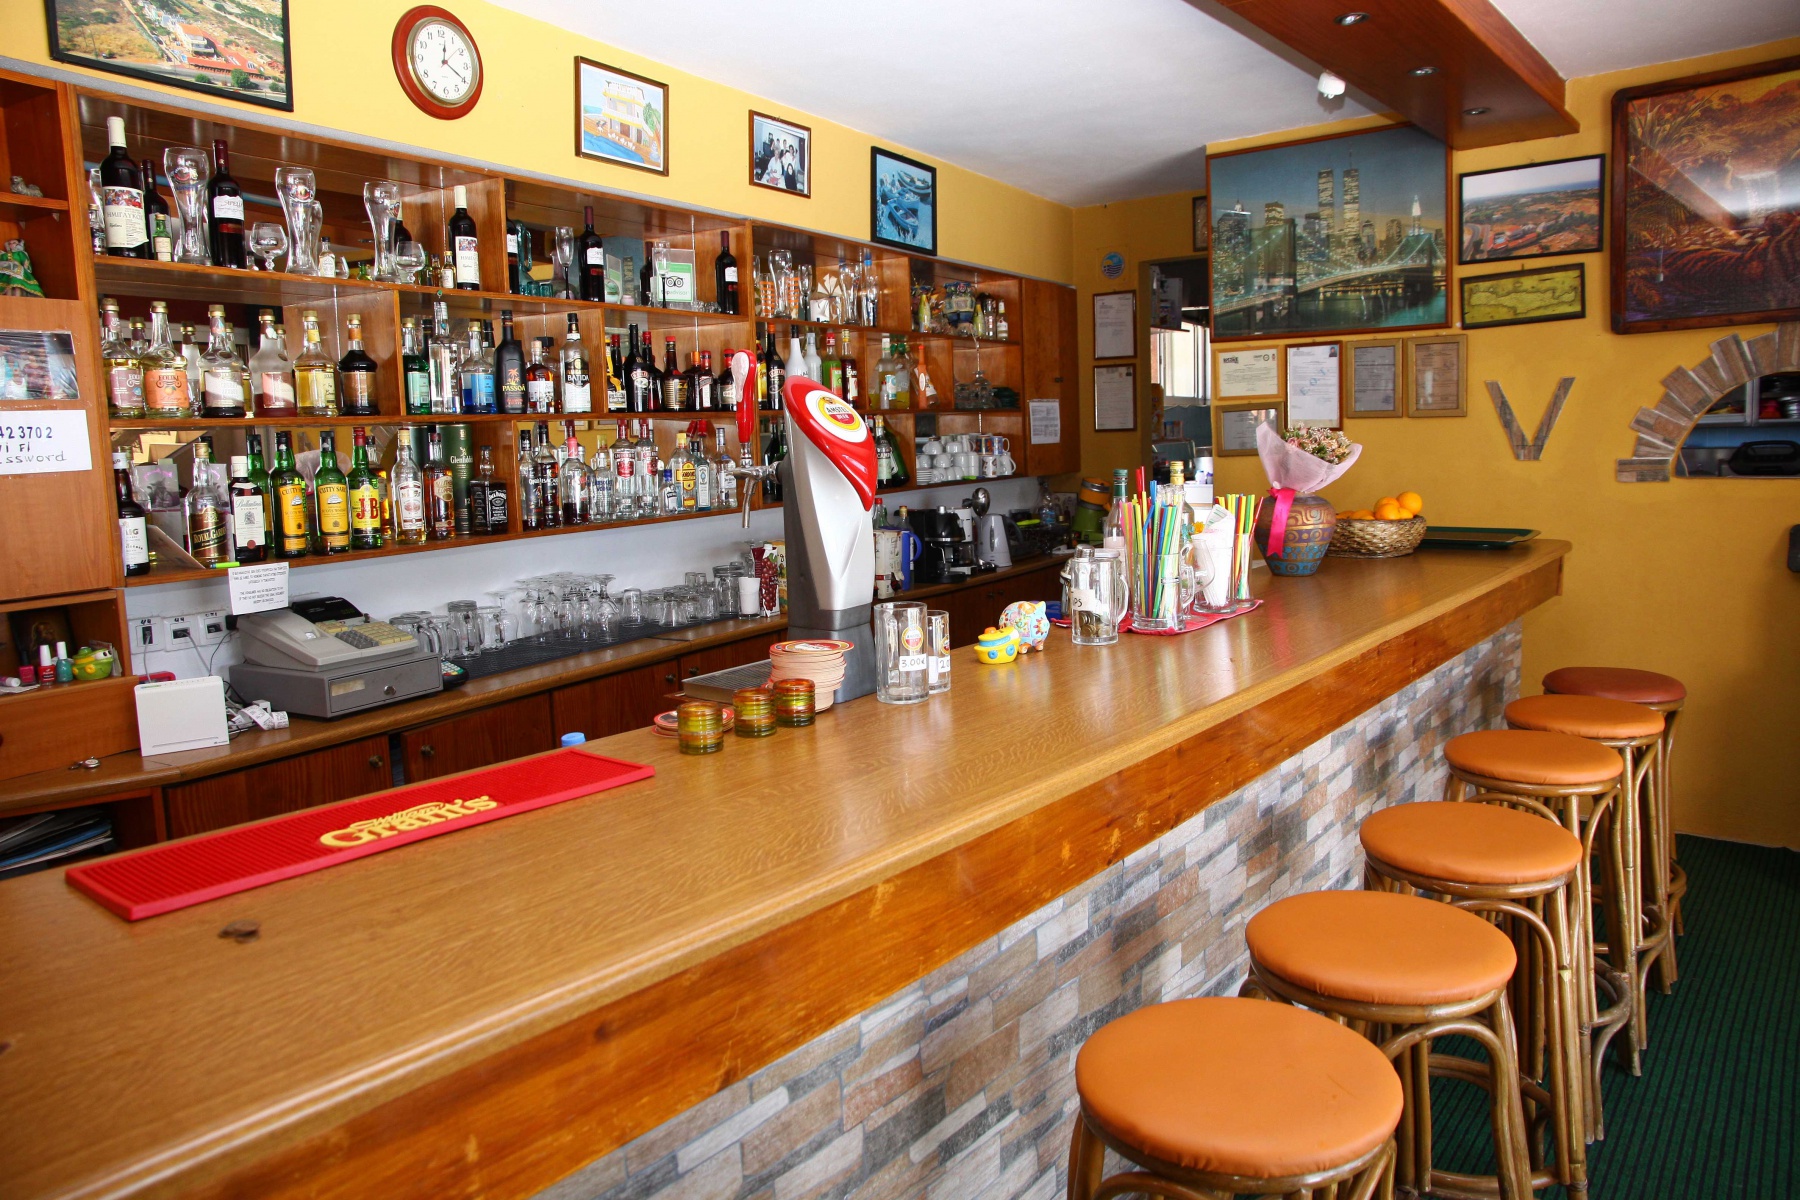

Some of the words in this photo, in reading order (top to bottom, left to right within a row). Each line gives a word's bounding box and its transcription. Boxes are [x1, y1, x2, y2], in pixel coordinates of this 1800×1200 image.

[427, 31, 433, 40] 11
[437, 29, 445, 39] 12
[451, 36, 455, 44] 1
[419, 40, 428, 50] 10
[458, 47, 464, 56] 2
[417, 53, 424, 63] 9
[463, 62, 469, 71] 3
[423, 69, 429, 78] 8
[432, 80, 438, 89] 7
[461, 76, 466, 84] 4
[443, 86, 450, 95] 6
[454, 84, 460, 93] 5
[825, 406, 850, 414] AMSTEL
